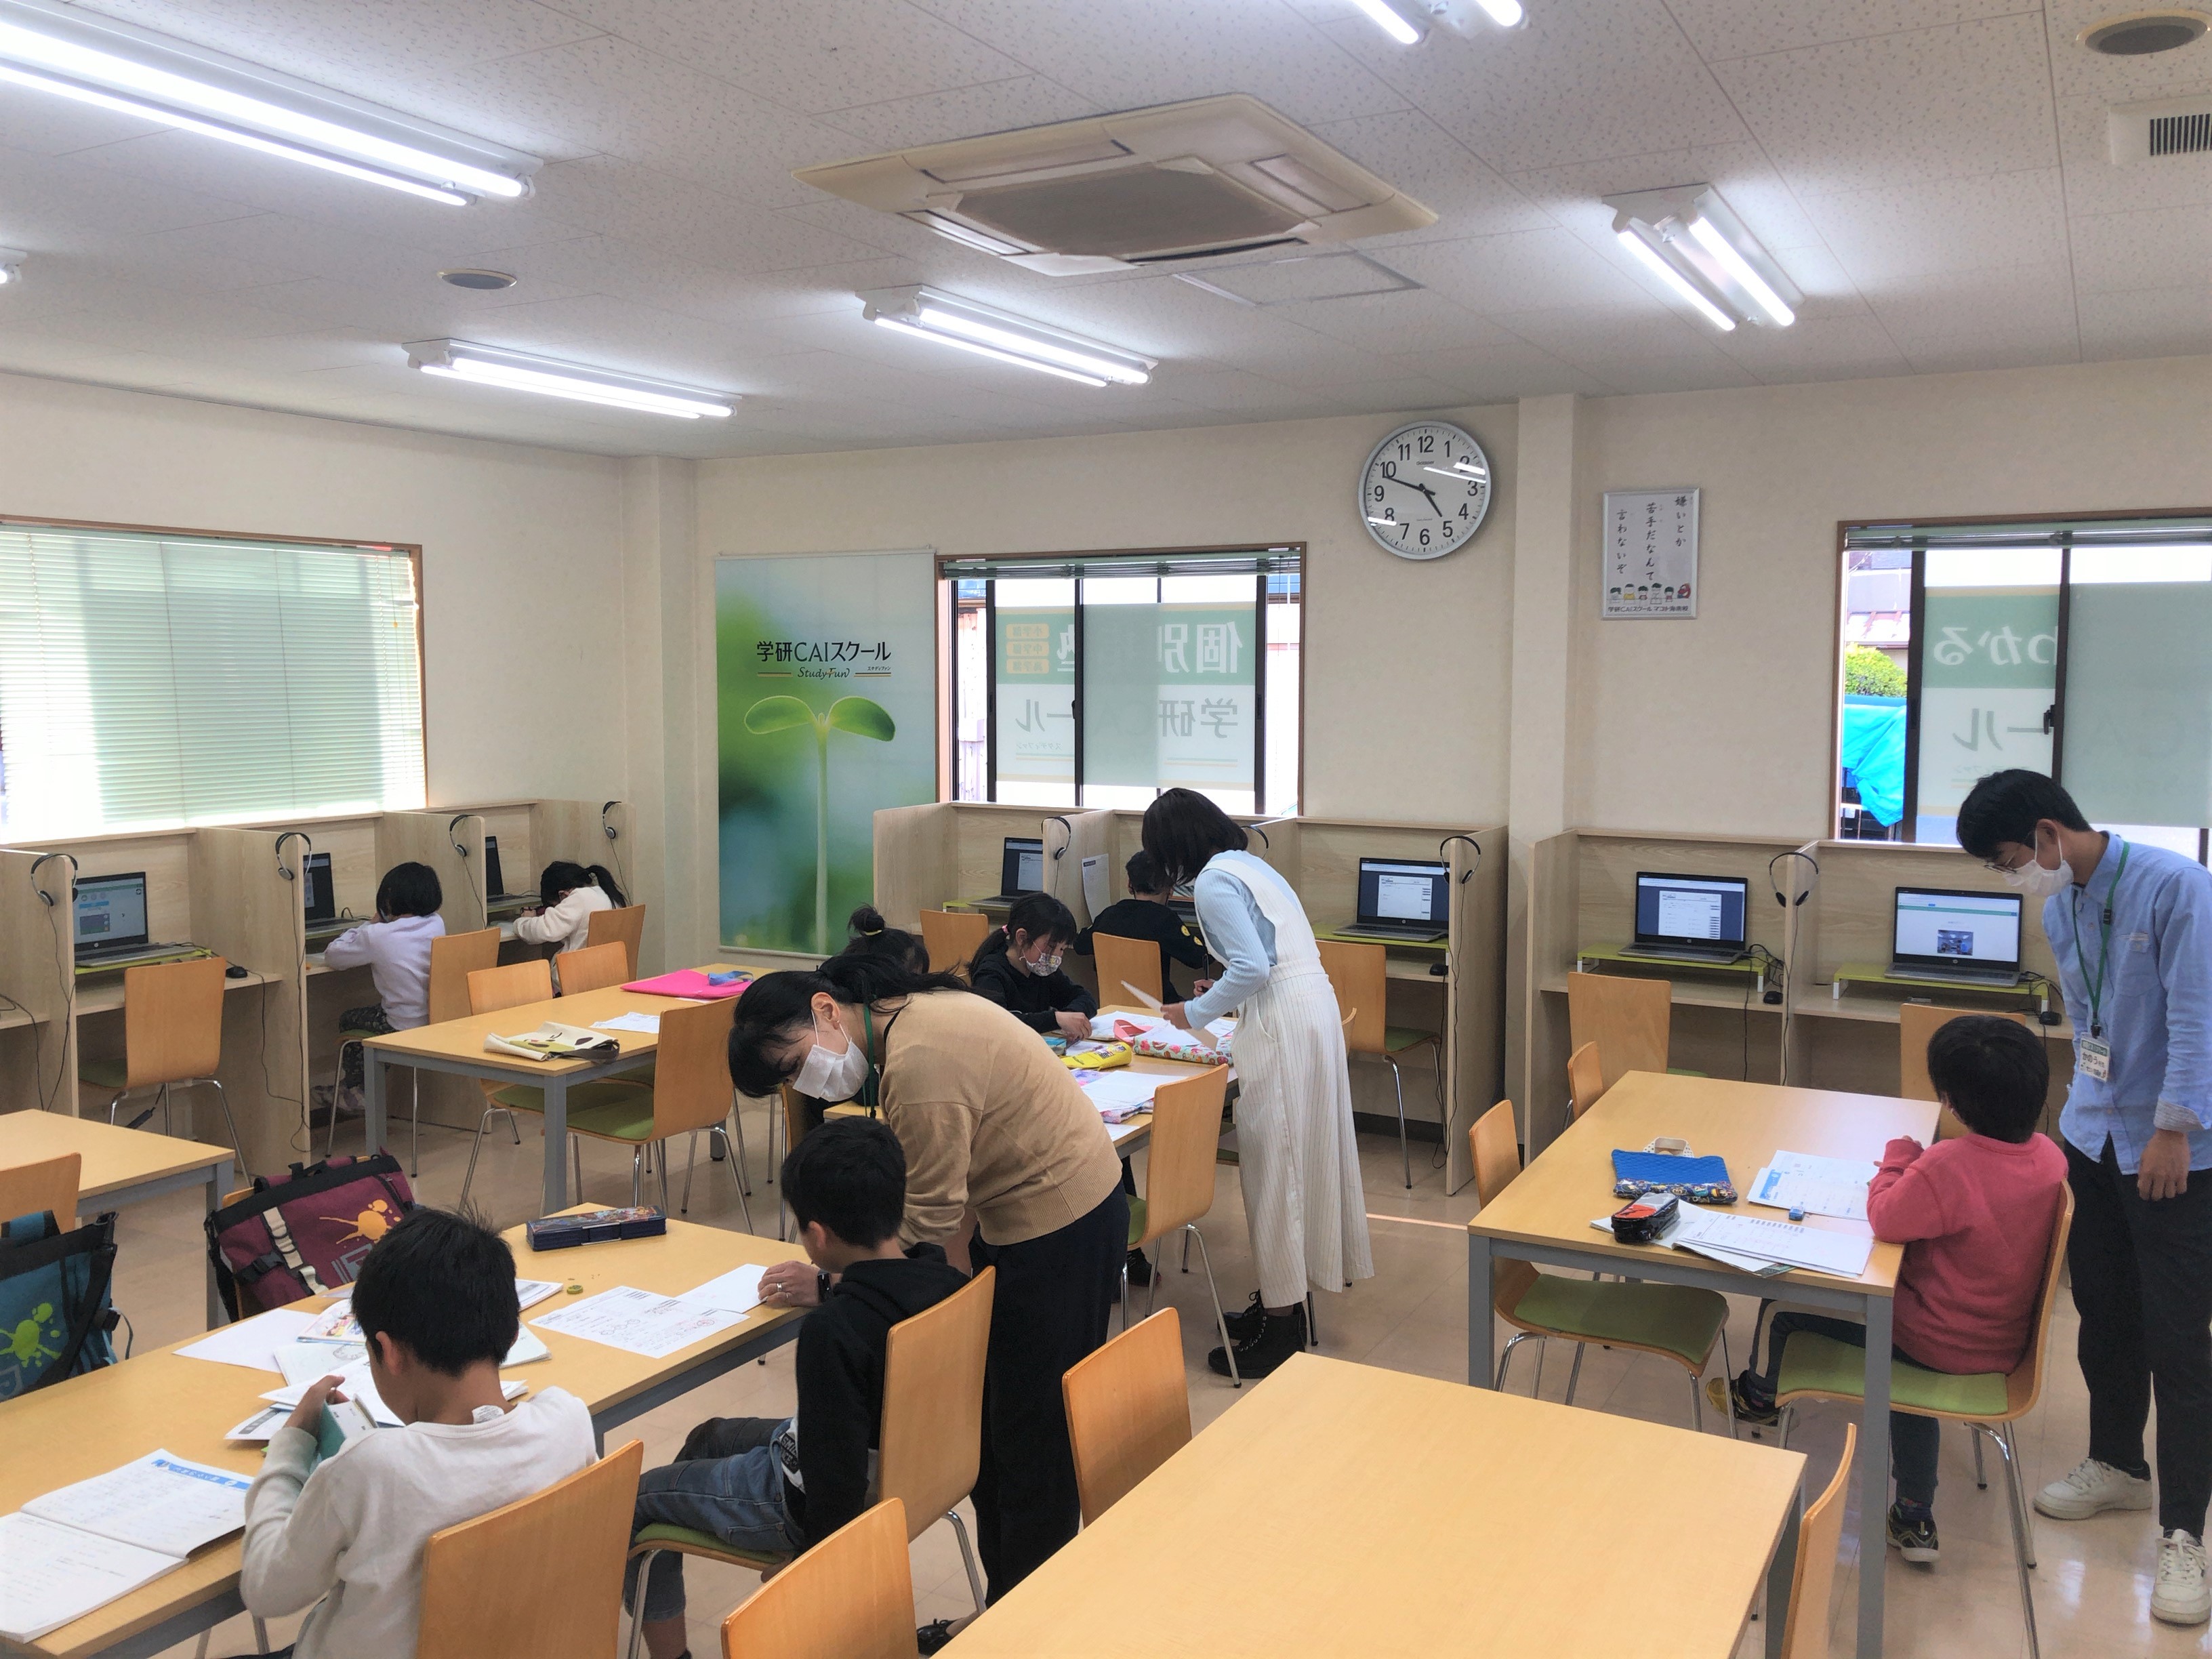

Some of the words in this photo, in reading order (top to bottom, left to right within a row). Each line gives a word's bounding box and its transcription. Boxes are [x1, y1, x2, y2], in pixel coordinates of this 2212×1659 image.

[1398, 443, 1410, 461] 11
[1418, 436, 1434, 453] 12
[1444, 441, 1451, 458] 1
[1380, 462, 1397, 478] 10
[1459, 455, 1470, 474] 2
[1374, 485, 1385, 503] 9
[1467, 480, 1479, 497] 3
[1385, 507, 1395, 522] 8
[1458, 503, 1469, 520] 4
[1399, 523, 1410, 540] 7
[1419, 529, 1431, 546] 6
[1442, 520, 1454, 538] 5
[756, 640, 892, 662] 学研CAIスクール
